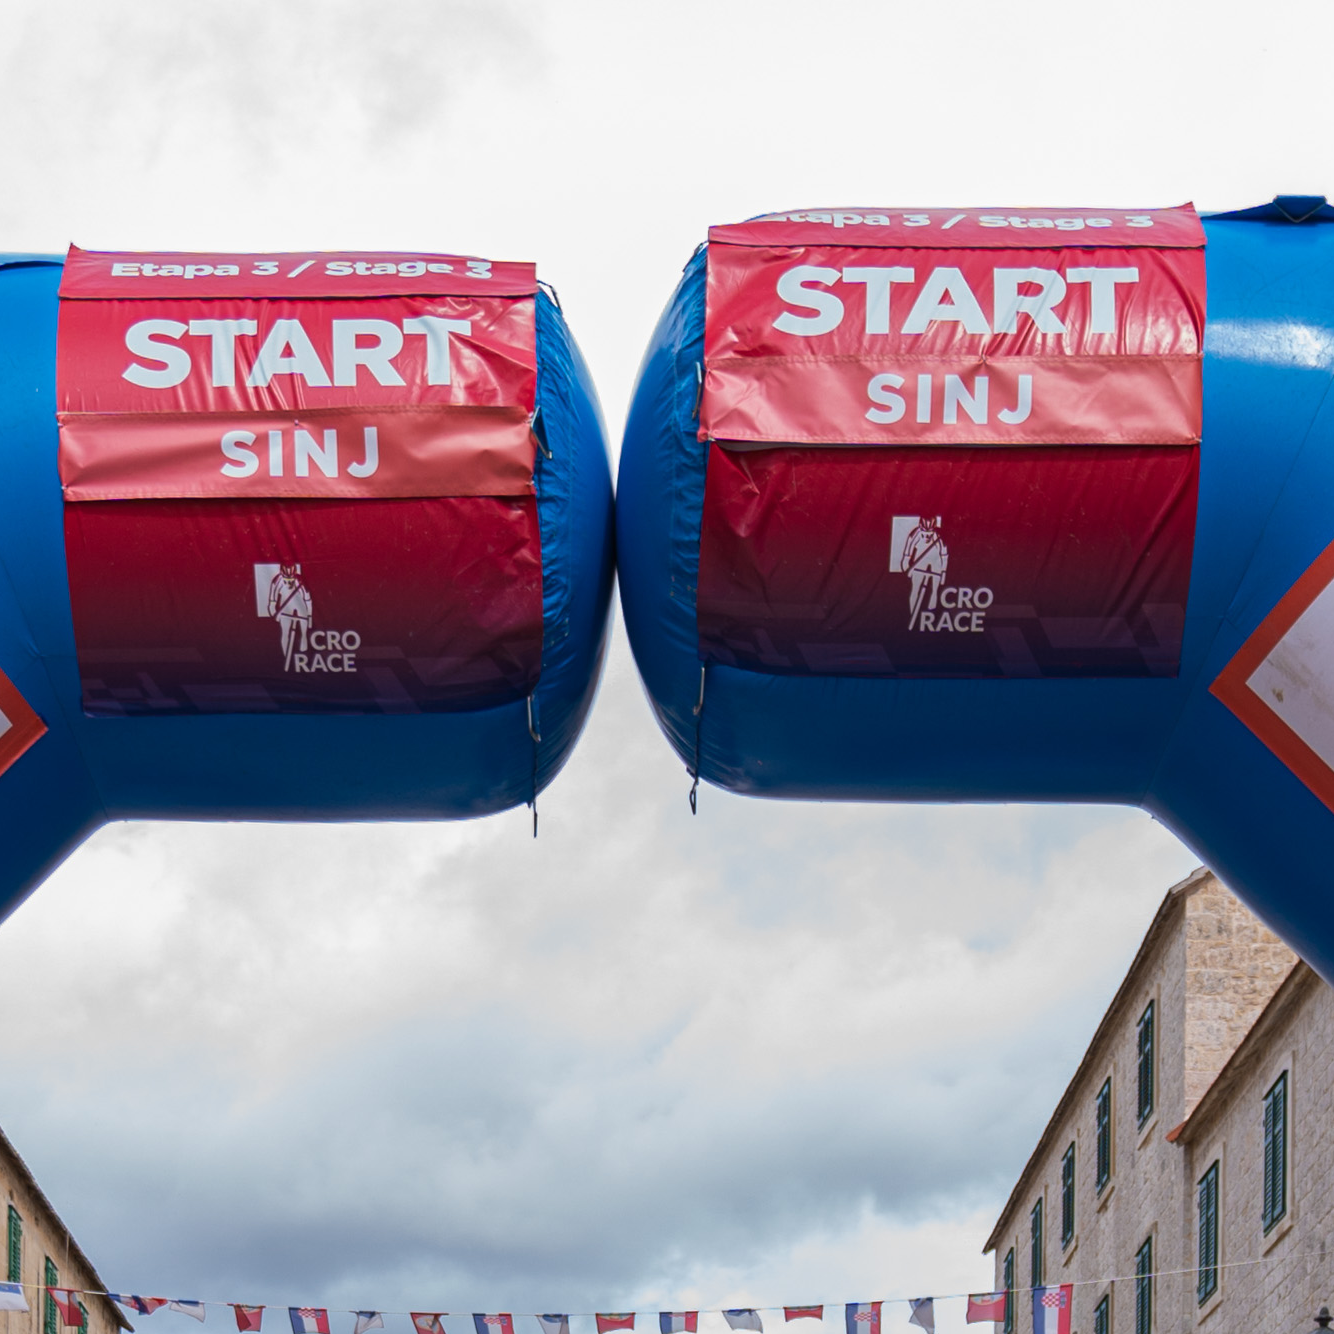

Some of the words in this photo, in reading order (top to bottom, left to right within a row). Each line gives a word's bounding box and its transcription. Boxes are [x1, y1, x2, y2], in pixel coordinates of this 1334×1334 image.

[903, 214, 931, 227] 3
[978, 214, 1113, 230] Stage
[1125, 215, 1154, 228] 3
[111, 262, 239, 279] Etapa
[251, 261, 279, 276] 3
[324, 260, 454, 280] Stage
[464, 261, 492, 279] 3
[771, 265, 1140, 337] START
[122, 316, 472, 389] START
[865, 374, 1033, 425] SINJ
[220, 426, 379, 478] SINJ
[940, 587, 994, 609] CRO
[919, 611, 986, 632] RACE
[310, 630, 362, 650] CRO
[294, 653, 357, 672] RACE
